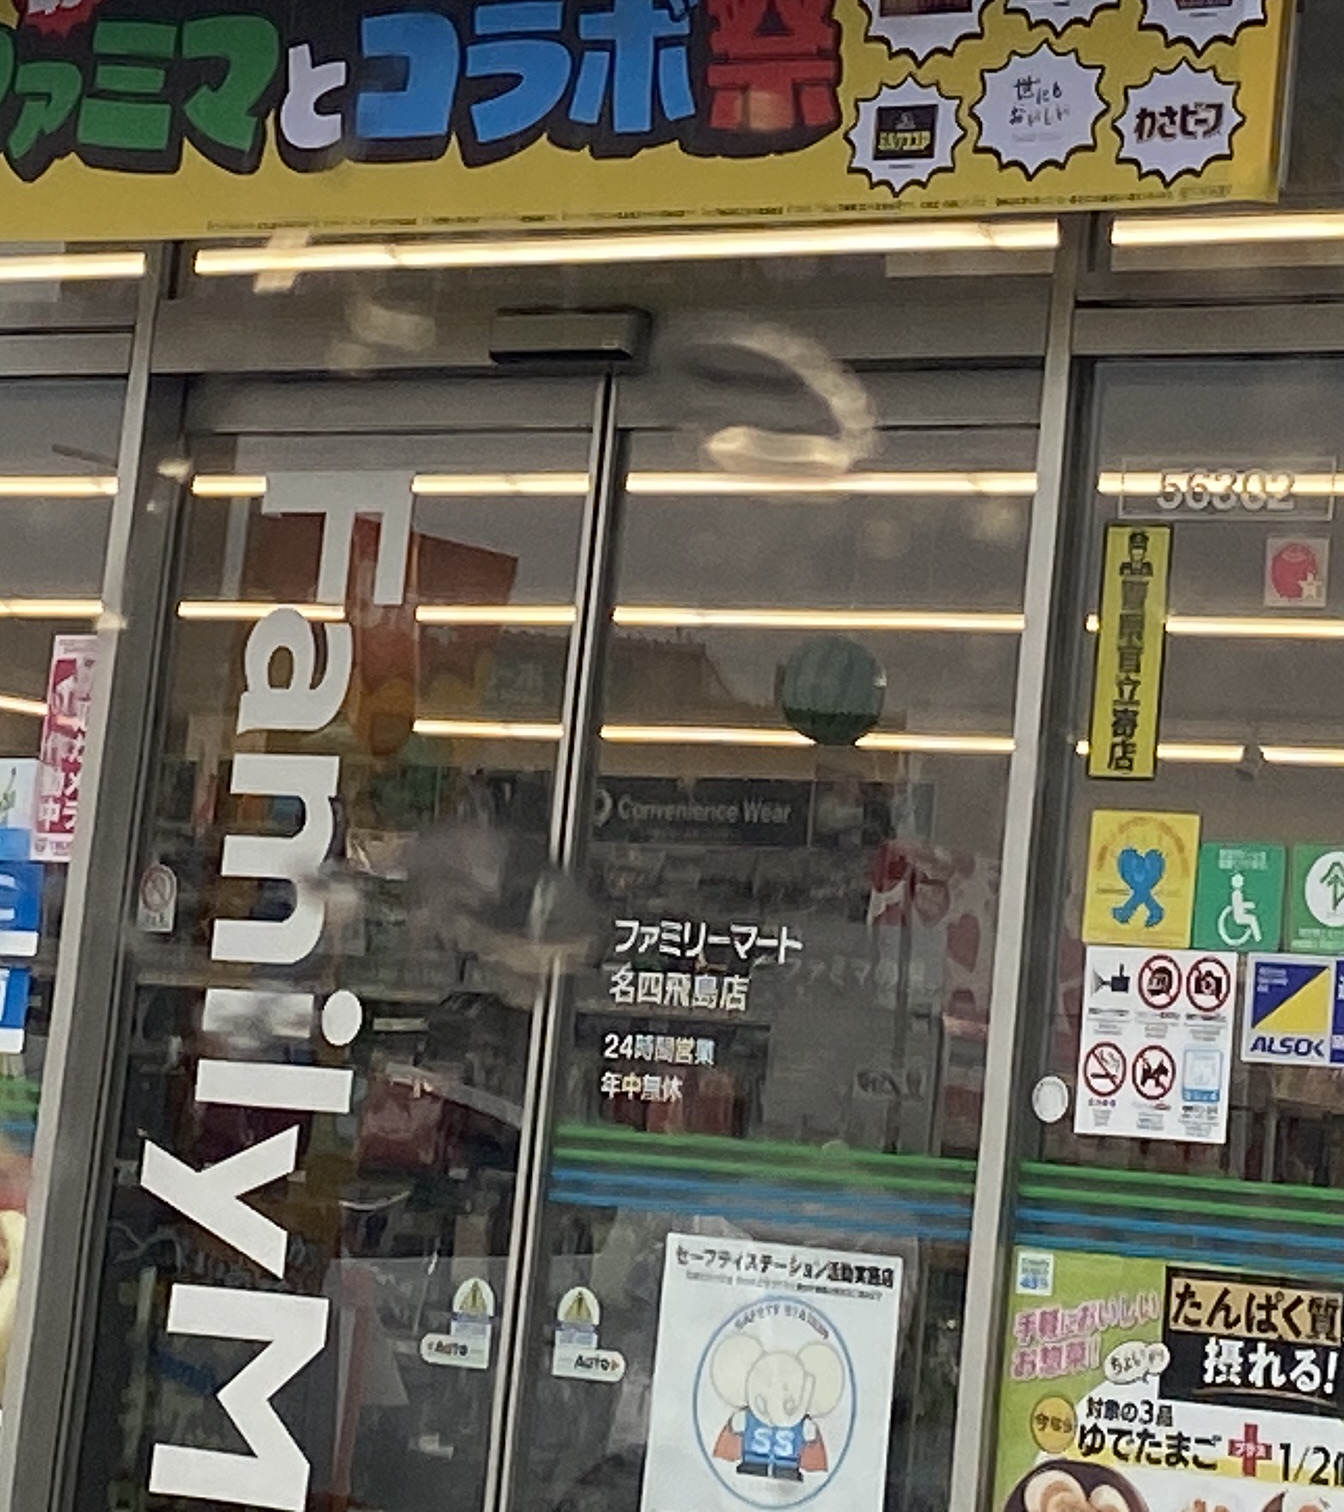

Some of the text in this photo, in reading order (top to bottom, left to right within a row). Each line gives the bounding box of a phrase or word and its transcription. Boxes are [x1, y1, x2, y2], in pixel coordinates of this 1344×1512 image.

[1134, 100, 1227, 145] わさビーフ
[618, 796, 793, 824] Convenience Wear
[614, 919, 804, 964] ファミリーマート
[609, 963, 750, 1011] 名四飛島店
[603, 1033, 716, 1065] 24時間営業
[1250, 1035, 1325, 1057] ALSOK
[600, 1072, 683, 1102] 年中無休
[734, 1302, 780, 1331] SAFETY
[1203, 1336, 1338, 1394] 摂れる!
[1035, 1410, 1074, 1434] 今なら
[1085, 1395, 1174, 1427] 対象の3品
[751, 1426, 797, 1456] SS
[1077, 1422, 1223, 1471] ゆでたまご
